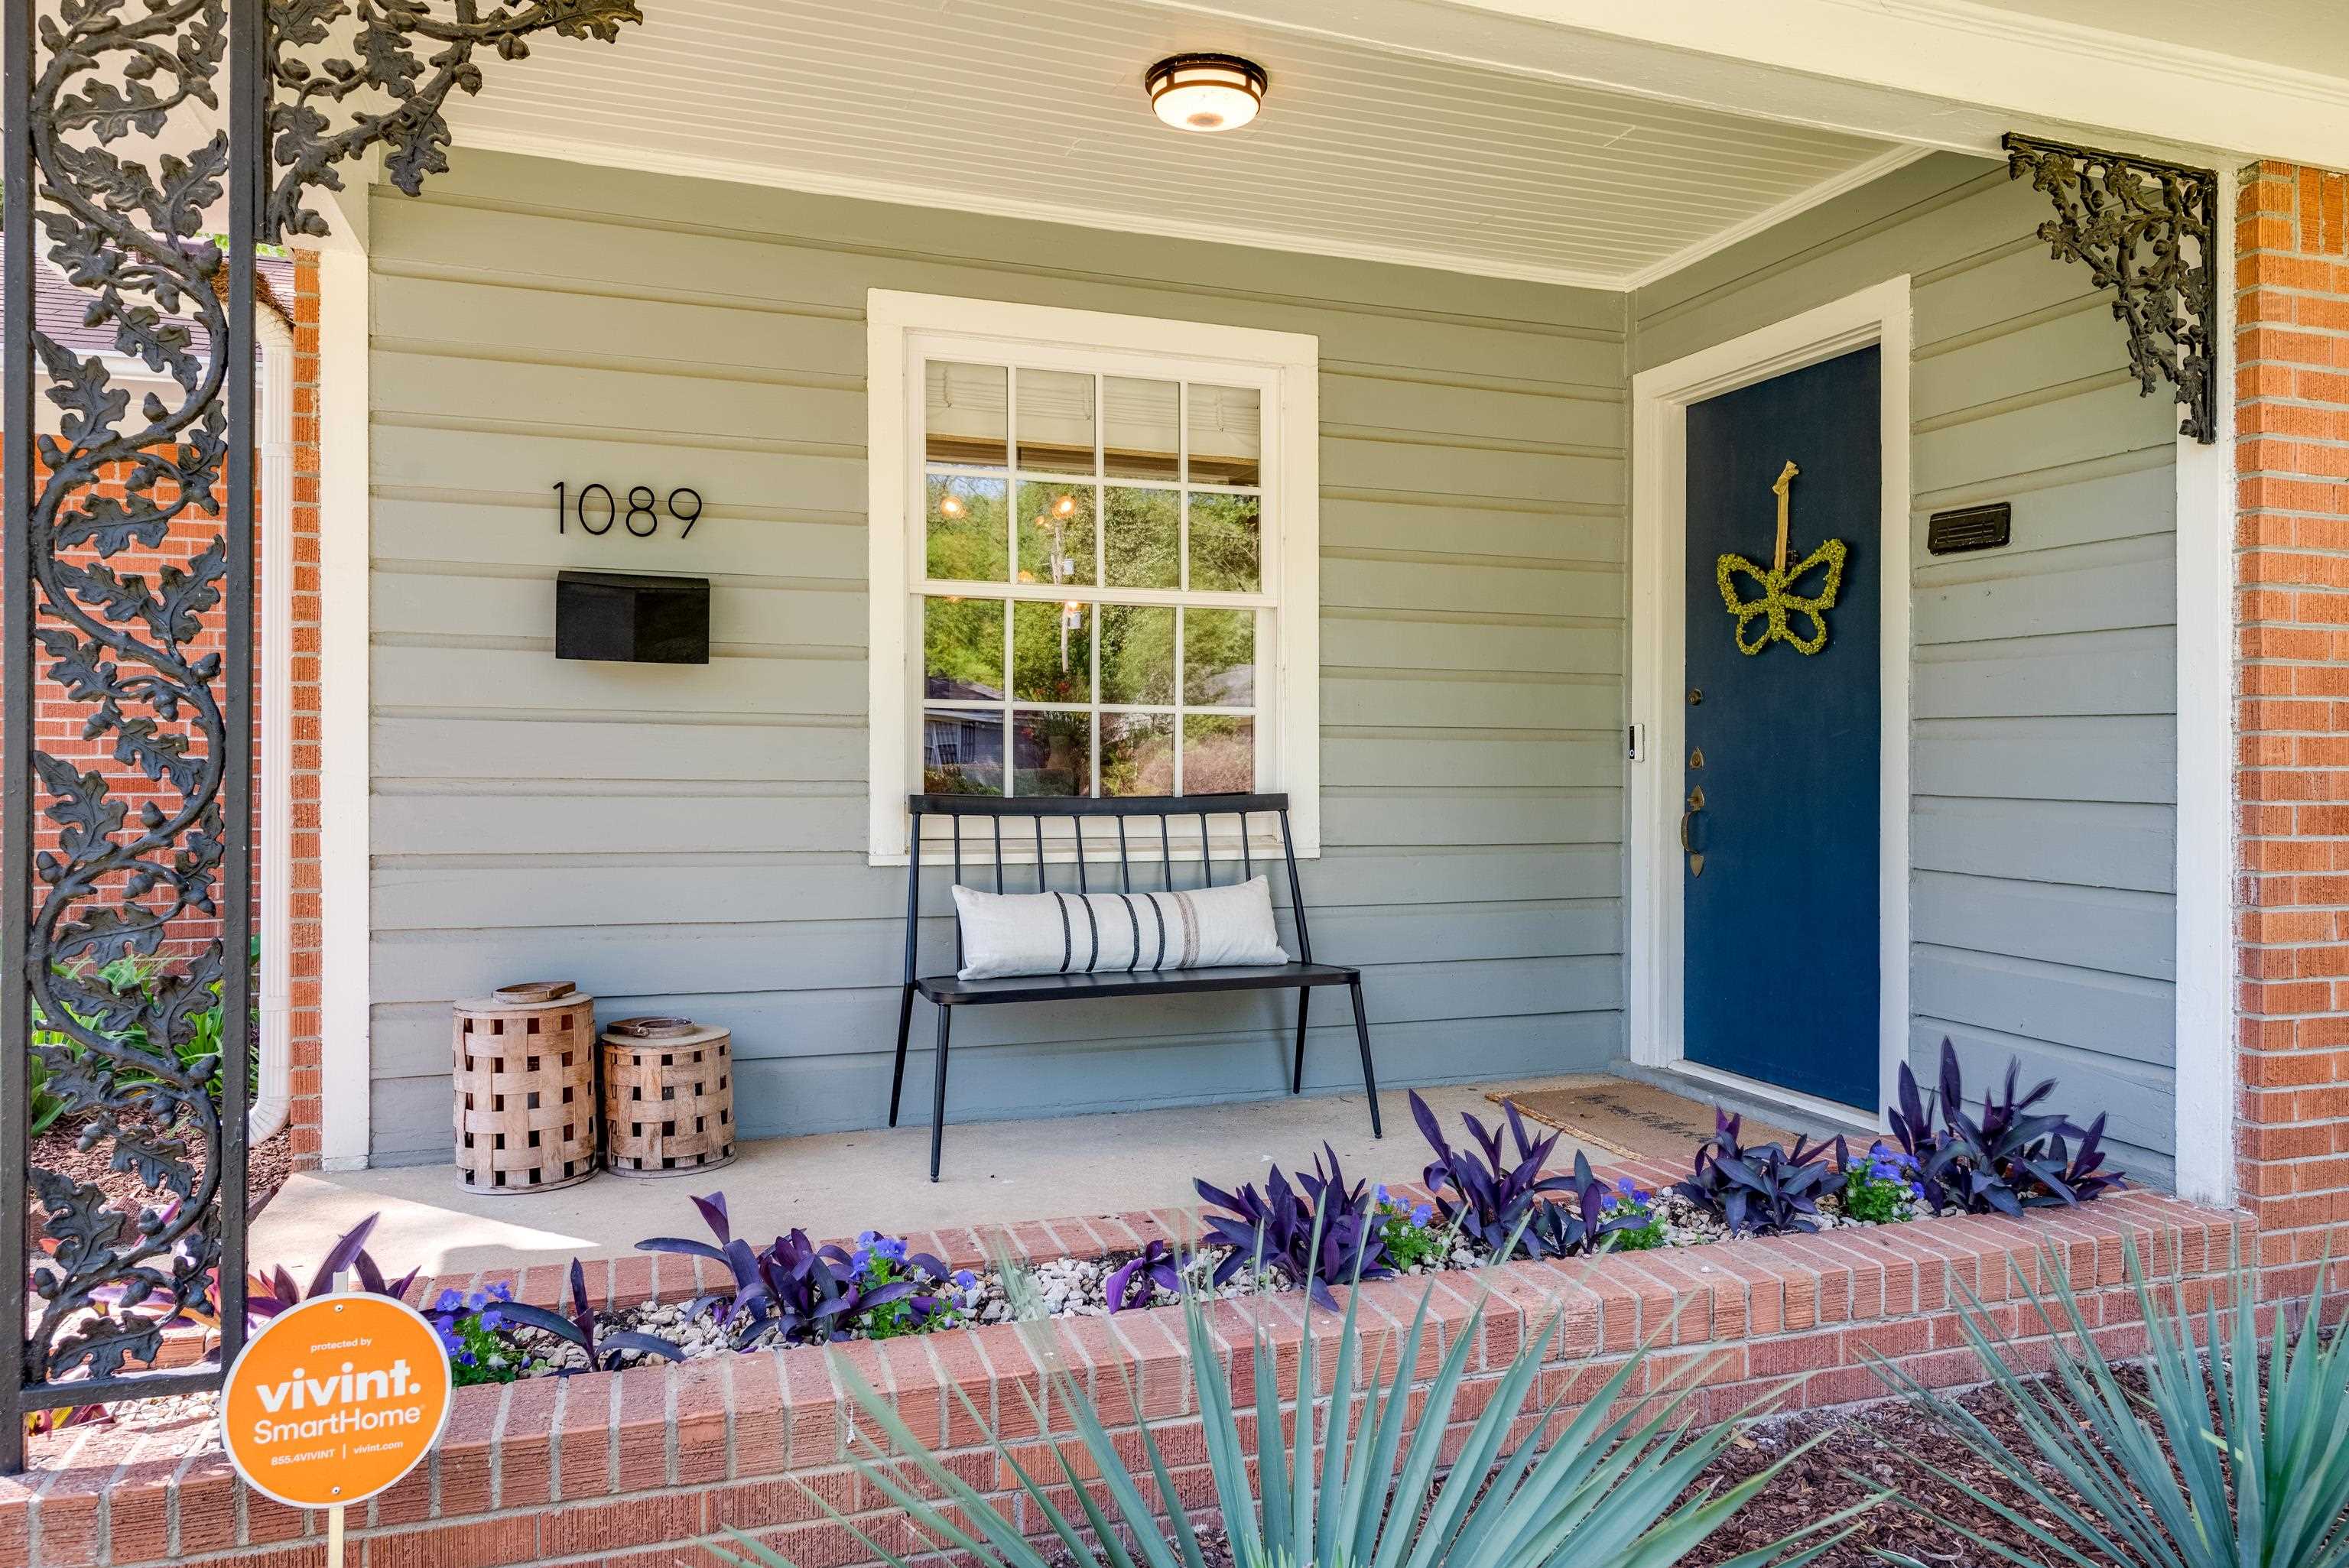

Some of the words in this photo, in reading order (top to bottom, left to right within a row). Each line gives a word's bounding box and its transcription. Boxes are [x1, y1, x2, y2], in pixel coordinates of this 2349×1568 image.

[552, 481, 703, 538] 1089
[310, 1339, 358, 1353] protected
[360, 1337, 372, 1350] by
[255, 1359, 421, 1414] vivint.
[253, 1407, 421, 1445] SmartHome
[270, 1449, 336, 1466] 855.4VIVINT
[353, 1441, 404, 1455] vivint.com
